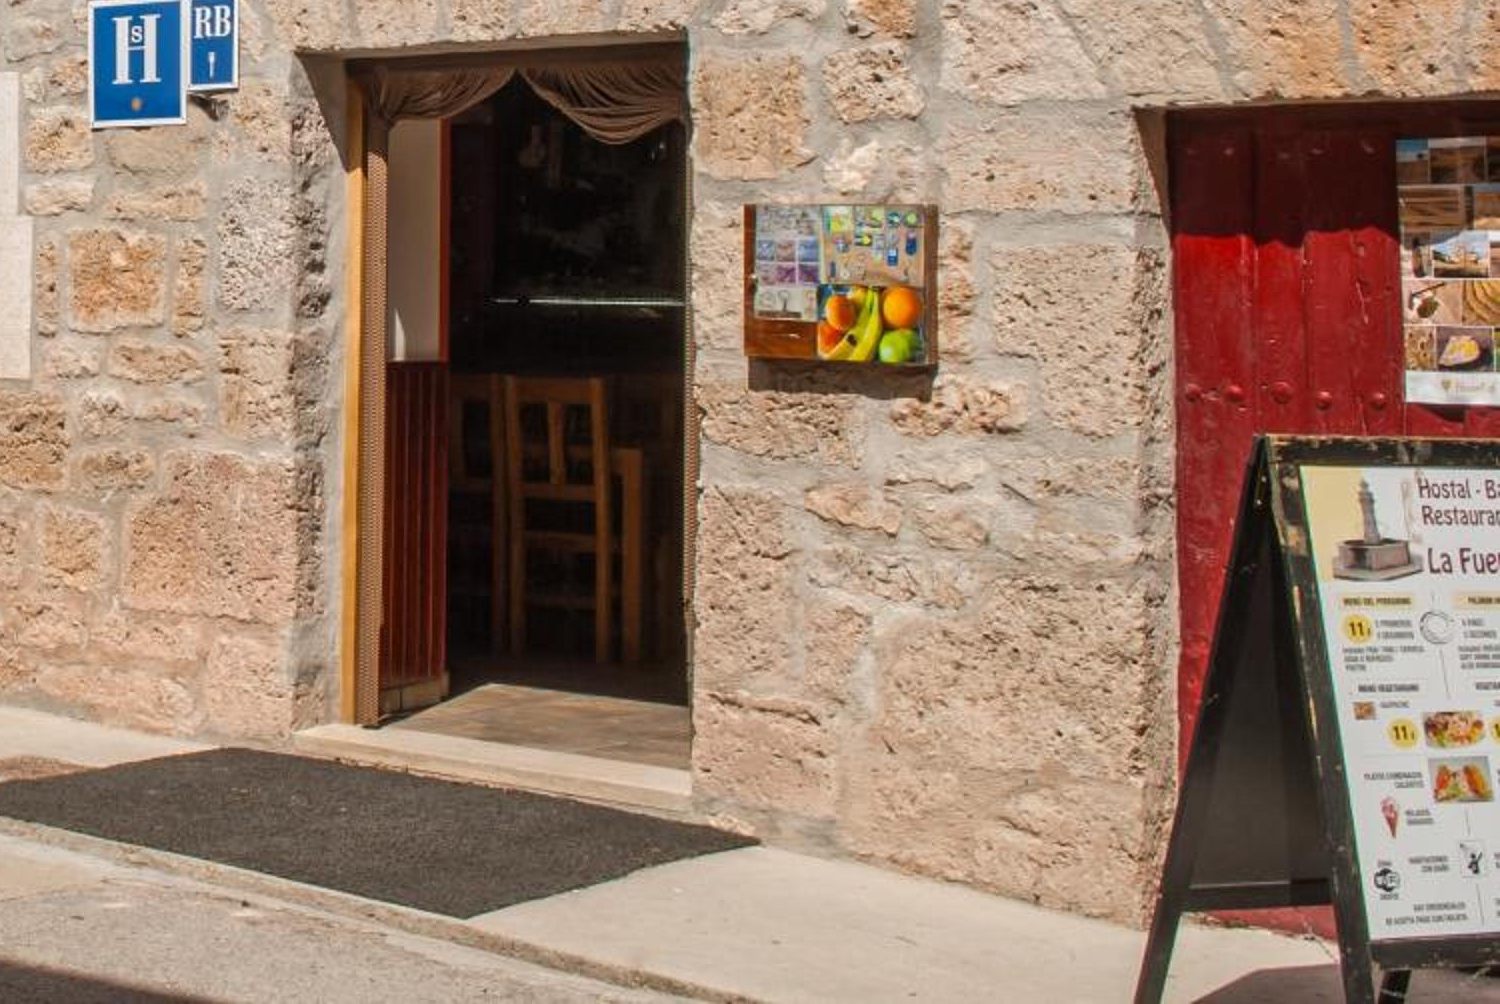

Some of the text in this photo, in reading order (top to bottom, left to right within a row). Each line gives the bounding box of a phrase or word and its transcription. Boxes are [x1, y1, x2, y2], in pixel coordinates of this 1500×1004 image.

[193, 5, 231, 39] RB
[1418, 478, 1471, 499] Hostal
[1485, 479, 1500, 499] B
[1427, 547, 1500, 574] La Fue
